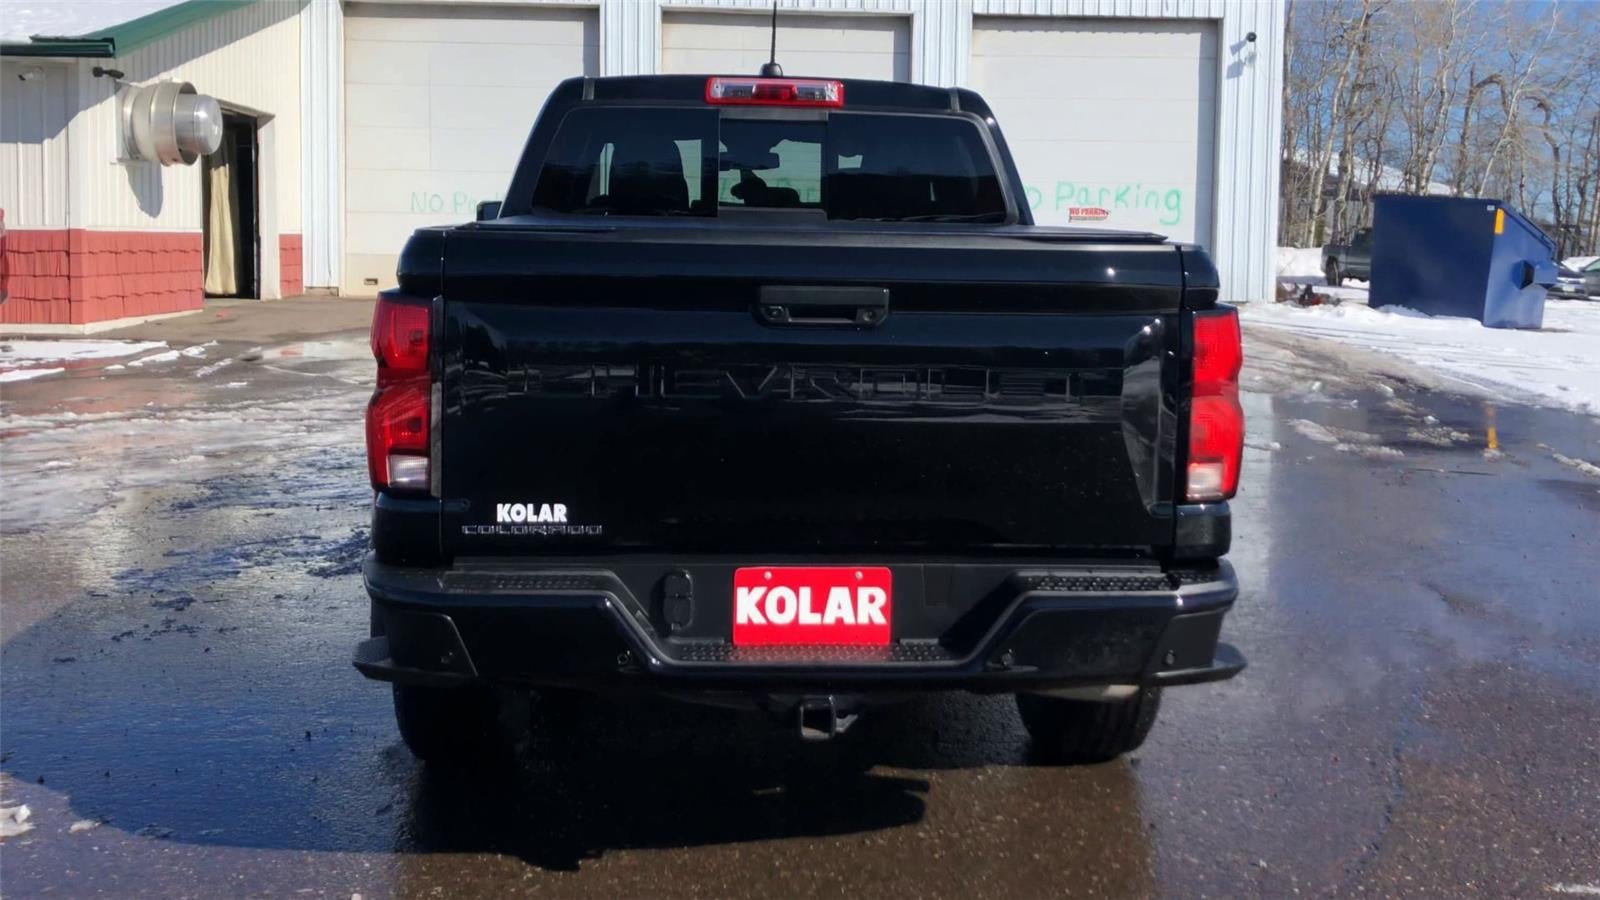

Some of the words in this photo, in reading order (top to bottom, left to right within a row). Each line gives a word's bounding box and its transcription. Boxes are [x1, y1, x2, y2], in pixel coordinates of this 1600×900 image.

[1055, 181, 1182, 226] Parking
[496, 503, 567, 522] KOLAR
[736, 586, 887, 625] KOLAR
